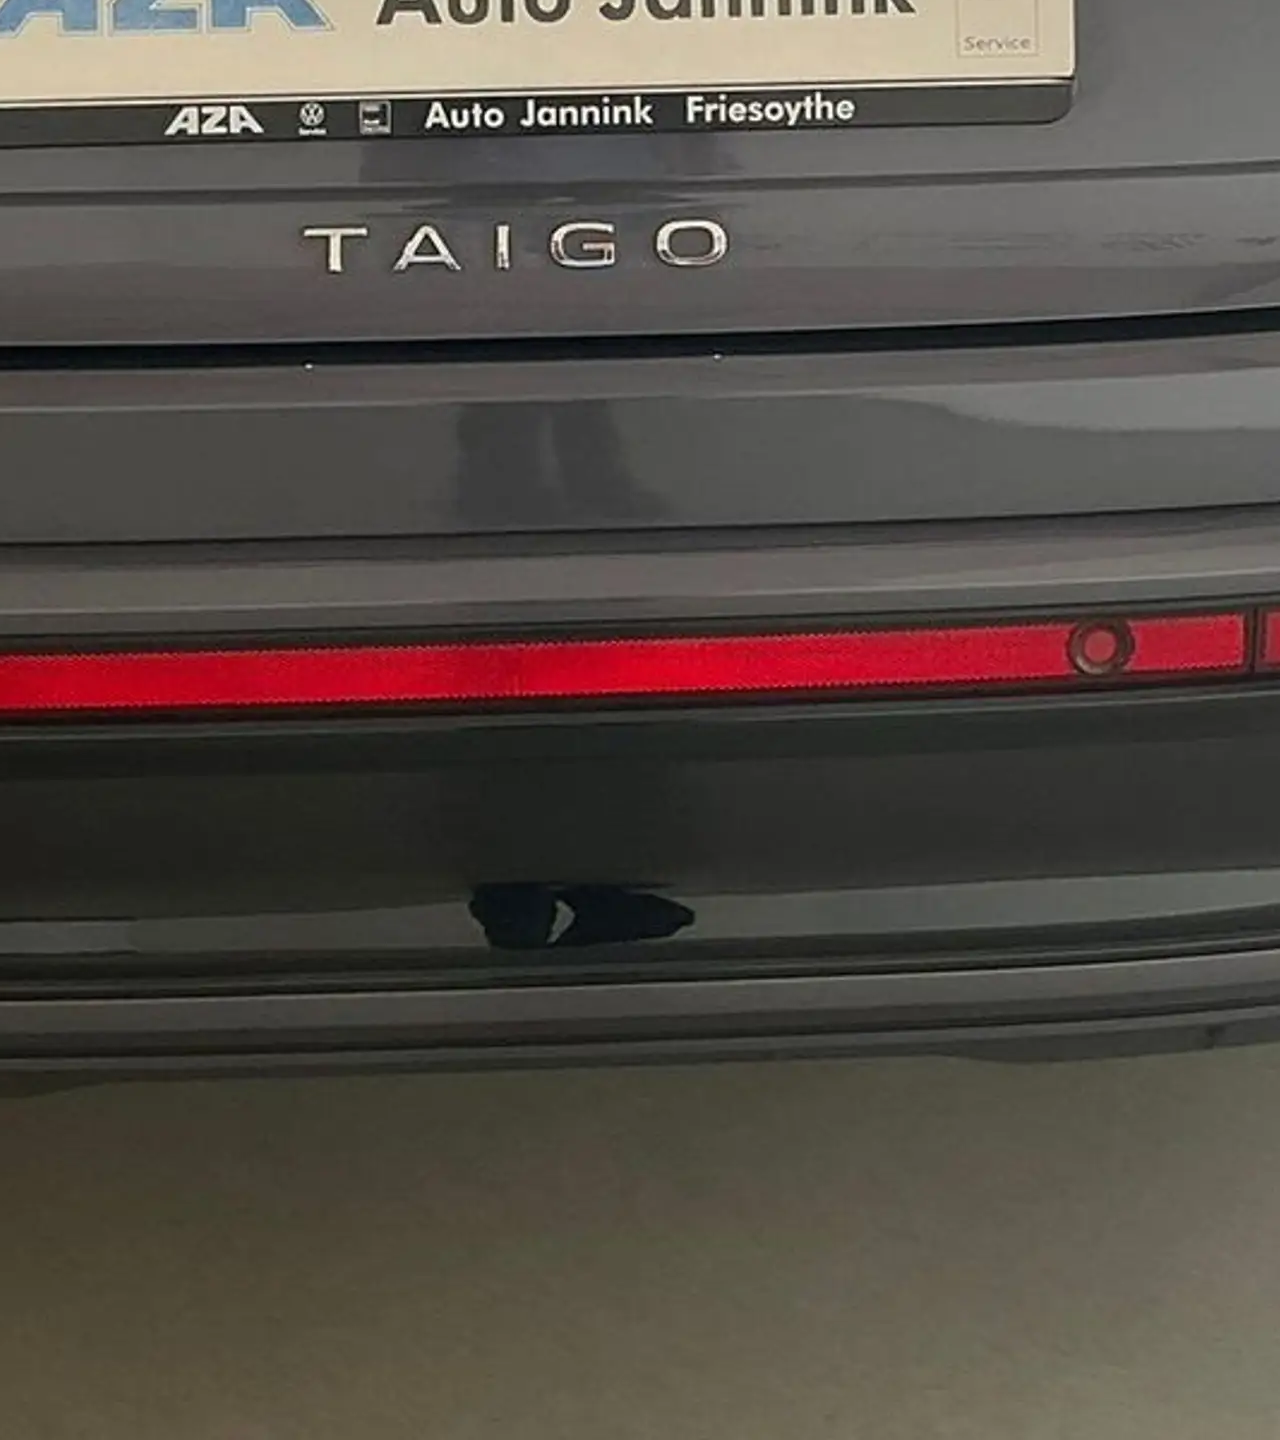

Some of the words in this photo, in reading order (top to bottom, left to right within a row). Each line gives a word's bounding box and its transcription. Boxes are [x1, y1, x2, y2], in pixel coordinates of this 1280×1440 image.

[962, 36, 1032, 51] Service
[163, 104, 265, 136] AZA
[425, 100, 505, 129] Auto
[519, 96, 653, 127] Jannink
[686, 92, 856, 125] Friesoythe
[303, 219, 728, 273] TAIGO
